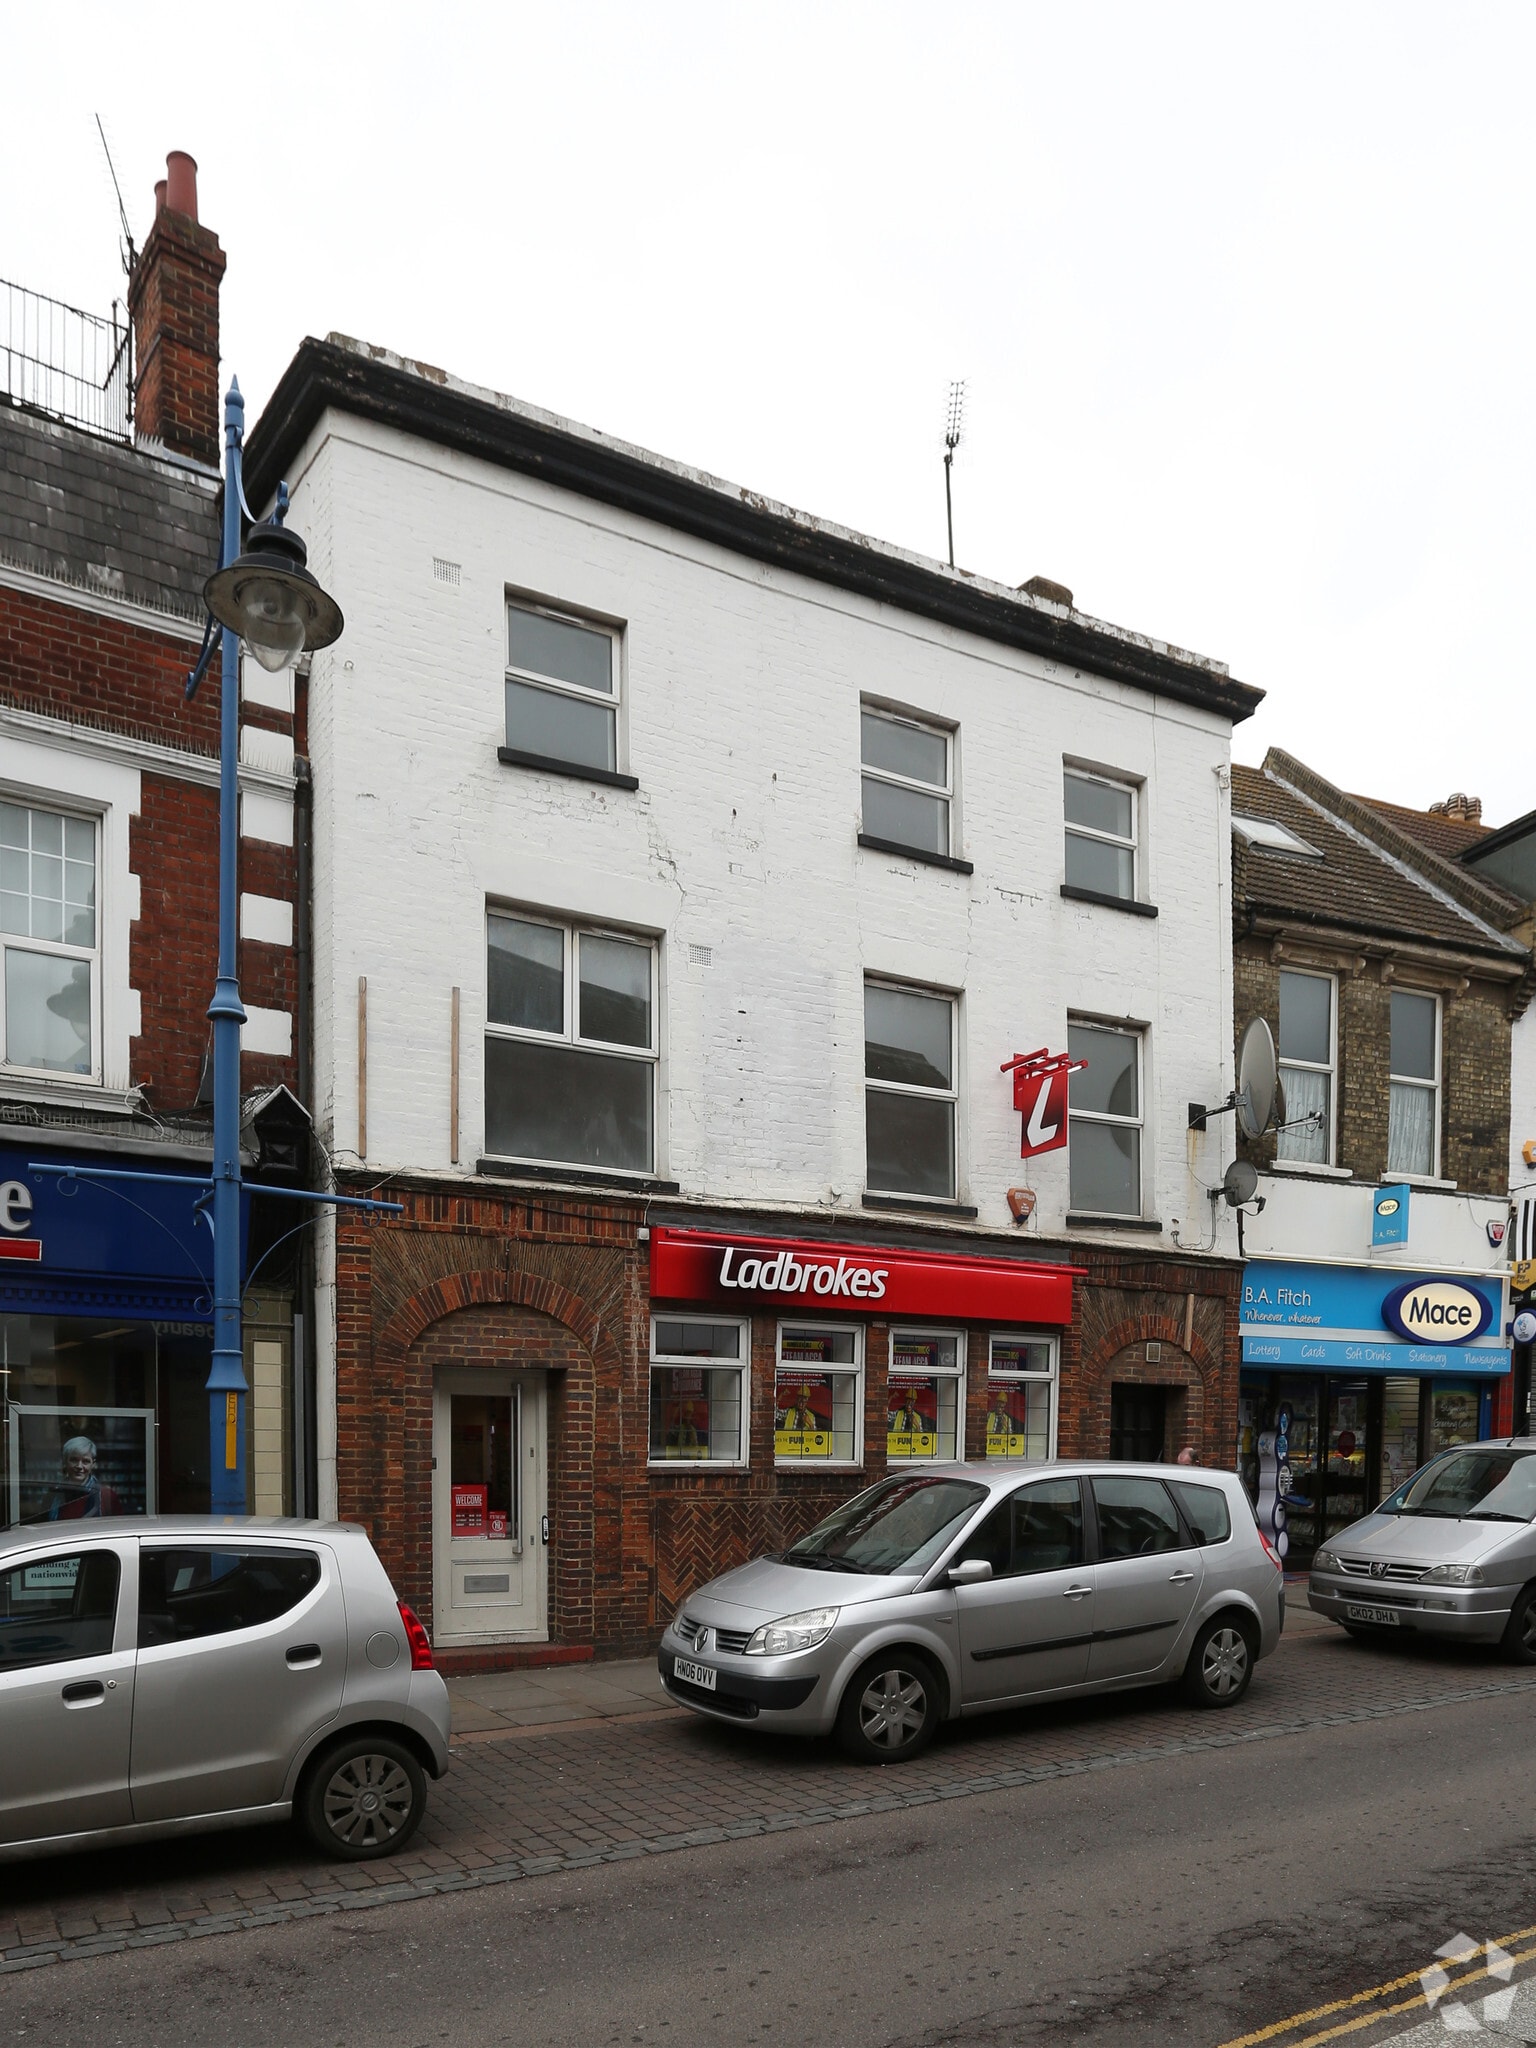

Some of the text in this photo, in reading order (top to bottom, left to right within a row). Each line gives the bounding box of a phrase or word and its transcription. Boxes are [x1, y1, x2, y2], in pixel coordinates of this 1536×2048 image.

[0, 1180, 33, 1232] e
[719, 1246, 889, 1299] Ladbrokes
[1244, 1286, 1312, 1307] B.A. Fitch
[1288, 1311, 1322, 1325] whatever
[1409, 1296, 1473, 1326] Mace
[1249, 1342, 1508, 1370] Lottery Cards Soft Drinks Stationery Newsagents
[789, 1436, 805, 1445] FUN
[897, 1437, 912, 1445] FUN
[455, 1495, 482, 1506] WELCOME
[31, 1570, 78, 1579] nationwid
[1351, 1607, 1395, 1623] GK02 DHA
[677, 1659, 713, 1686] HN06 OVV
